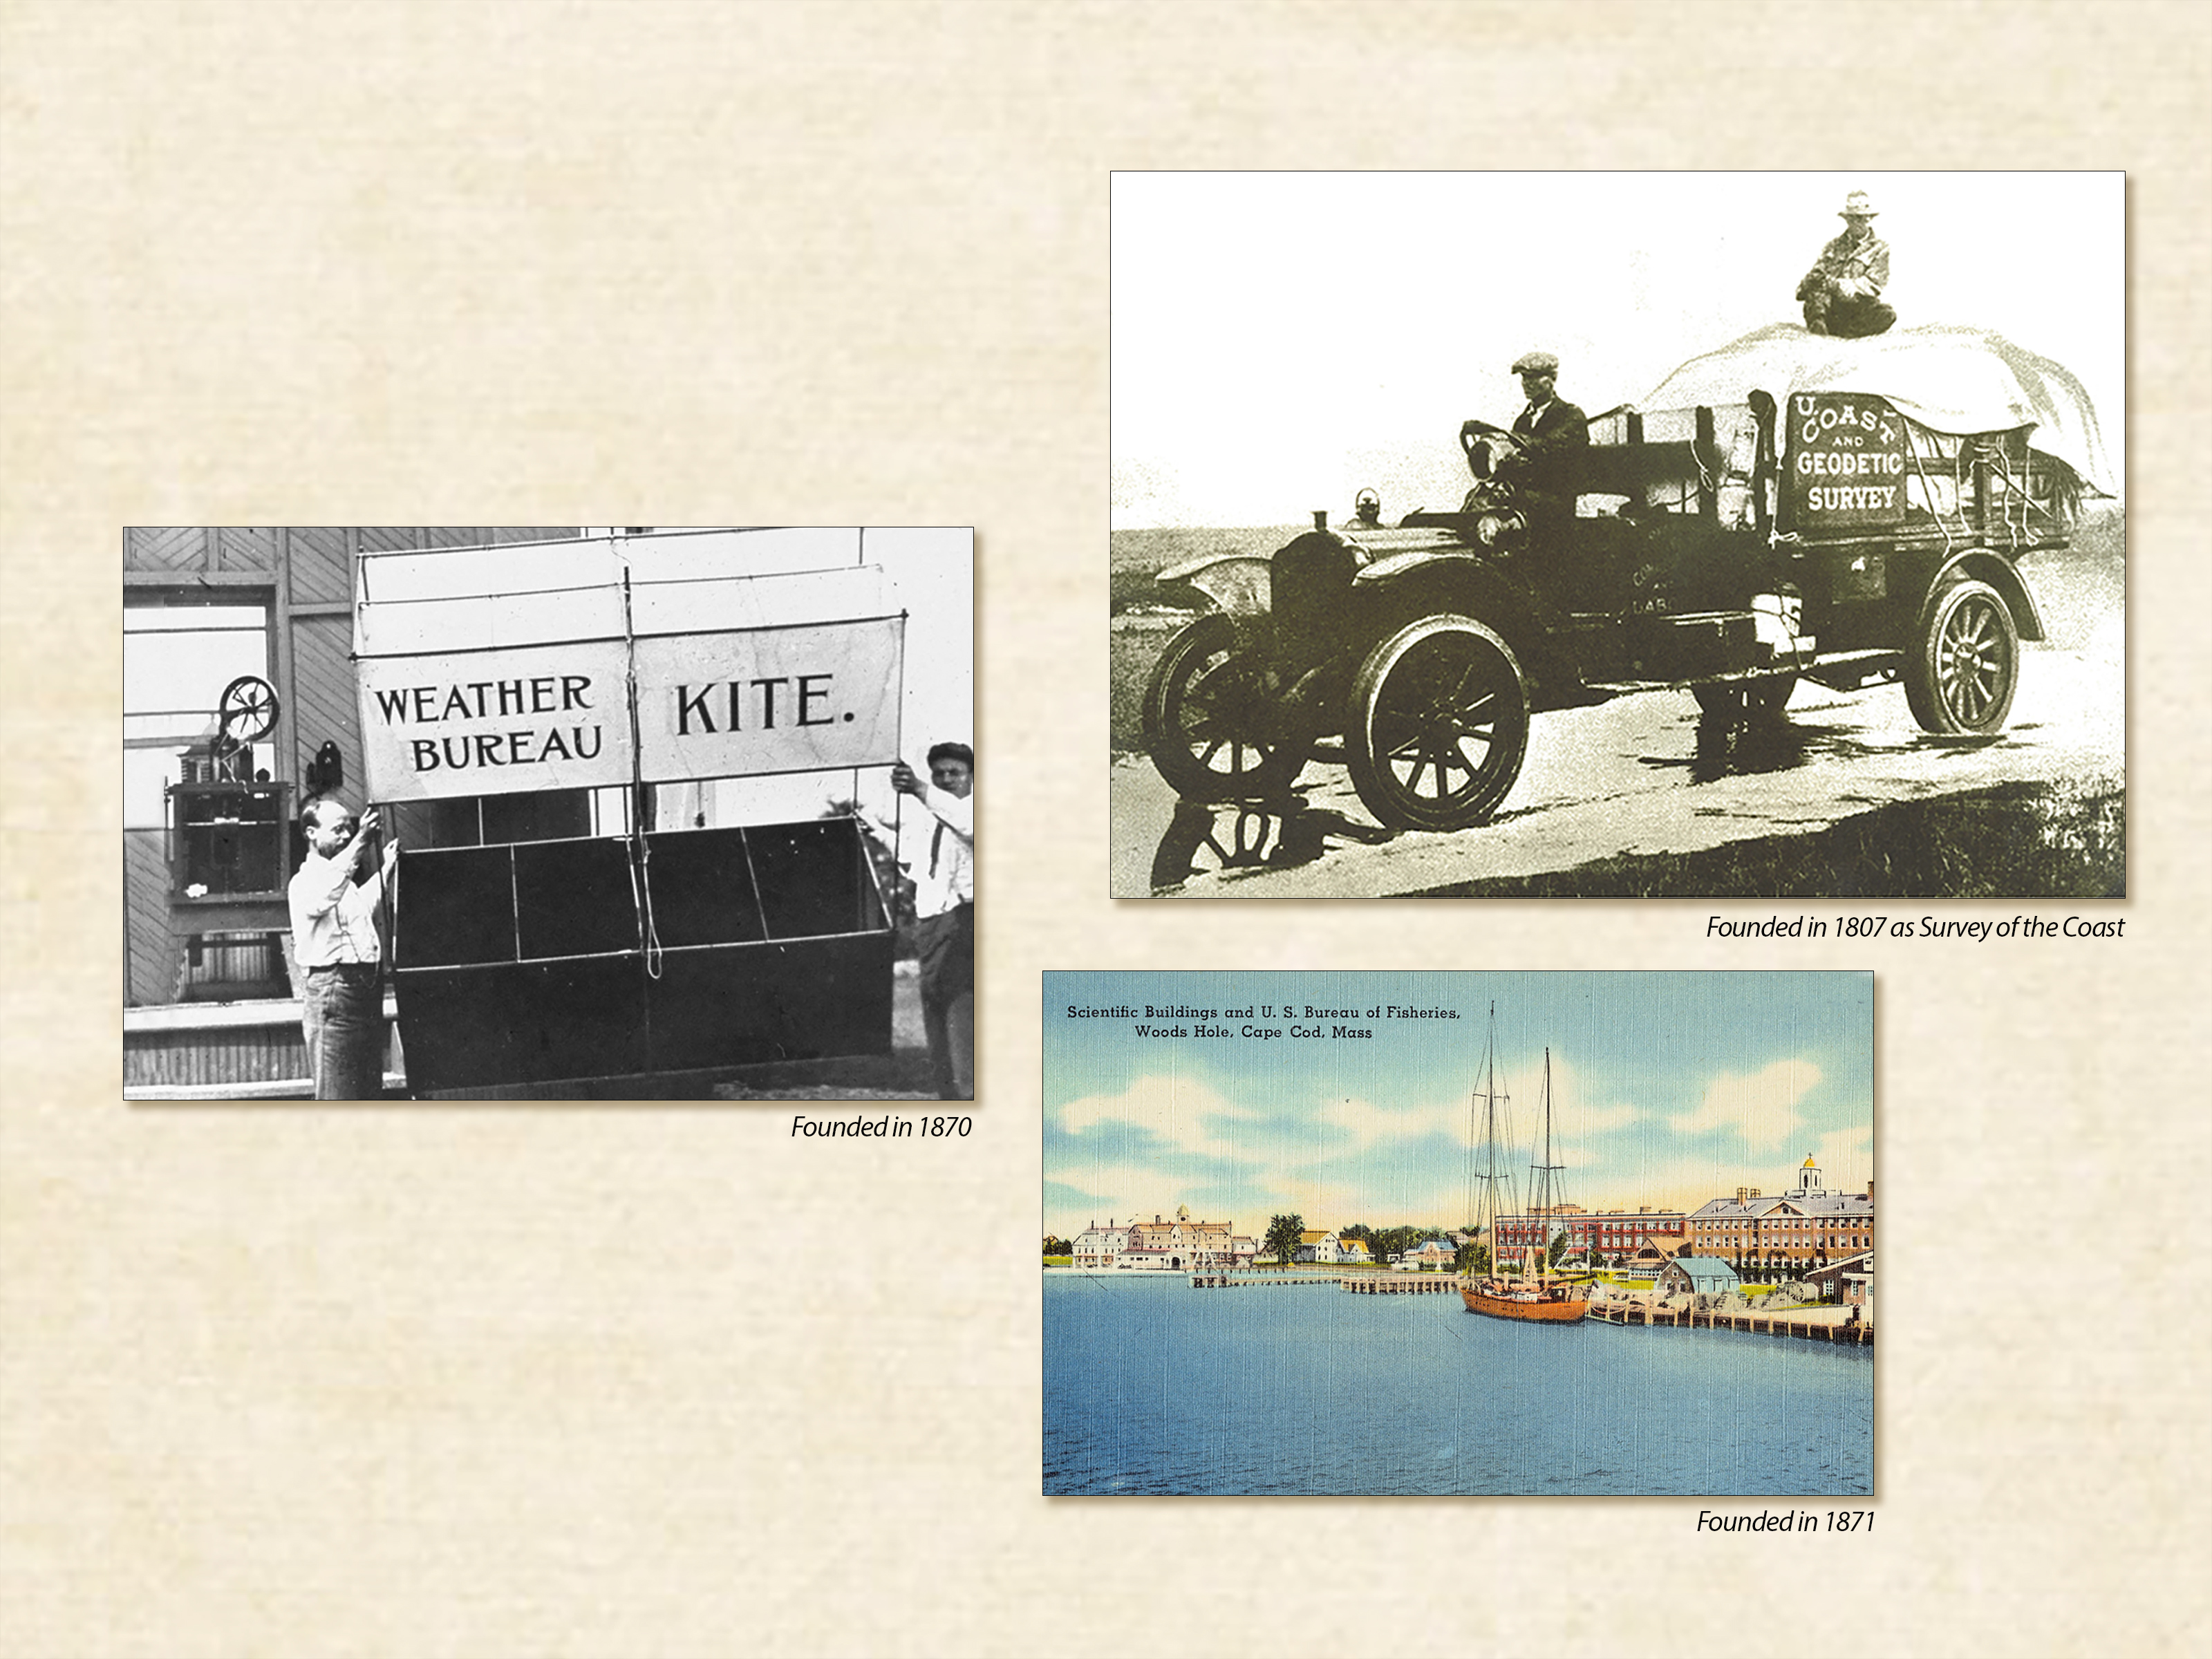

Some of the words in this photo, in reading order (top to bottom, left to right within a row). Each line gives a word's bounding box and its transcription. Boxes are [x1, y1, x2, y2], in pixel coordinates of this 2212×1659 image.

[1802, 405, 1896, 445] COAST
[1832, 436, 1864, 447] AND
[1797, 451, 1903, 475] GEODETIC
[1808, 486, 1897, 511] SURVEY
[373, 675, 594, 726] WEATHER
[675, 673, 855, 736] KITE.
[411, 724, 603, 773] BUREAU
[1067, 1005, 1138, 1018] Scientific
[1145, 1005, 1218, 1021] Buildings
[1224, 1005, 1255, 1018] and
[1261, 1005, 1277, 1018] U.
[1283, 1005, 1297, 1018] S.
[1304, 1005, 1360, 1018] Bureau
[1366, 1005, 1380, 1018] of
[1387, 1005, 1461, 1020] Fisheries,
[1134, 1024, 1188, 1038] Woods
[1194, 1024, 1235, 1038] Hole,
[1241, 1024, 1282, 1040] Cape
[1290, 1025, 1326, 1038] Cod,
[1332, 1025, 1373, 1039] Mass
